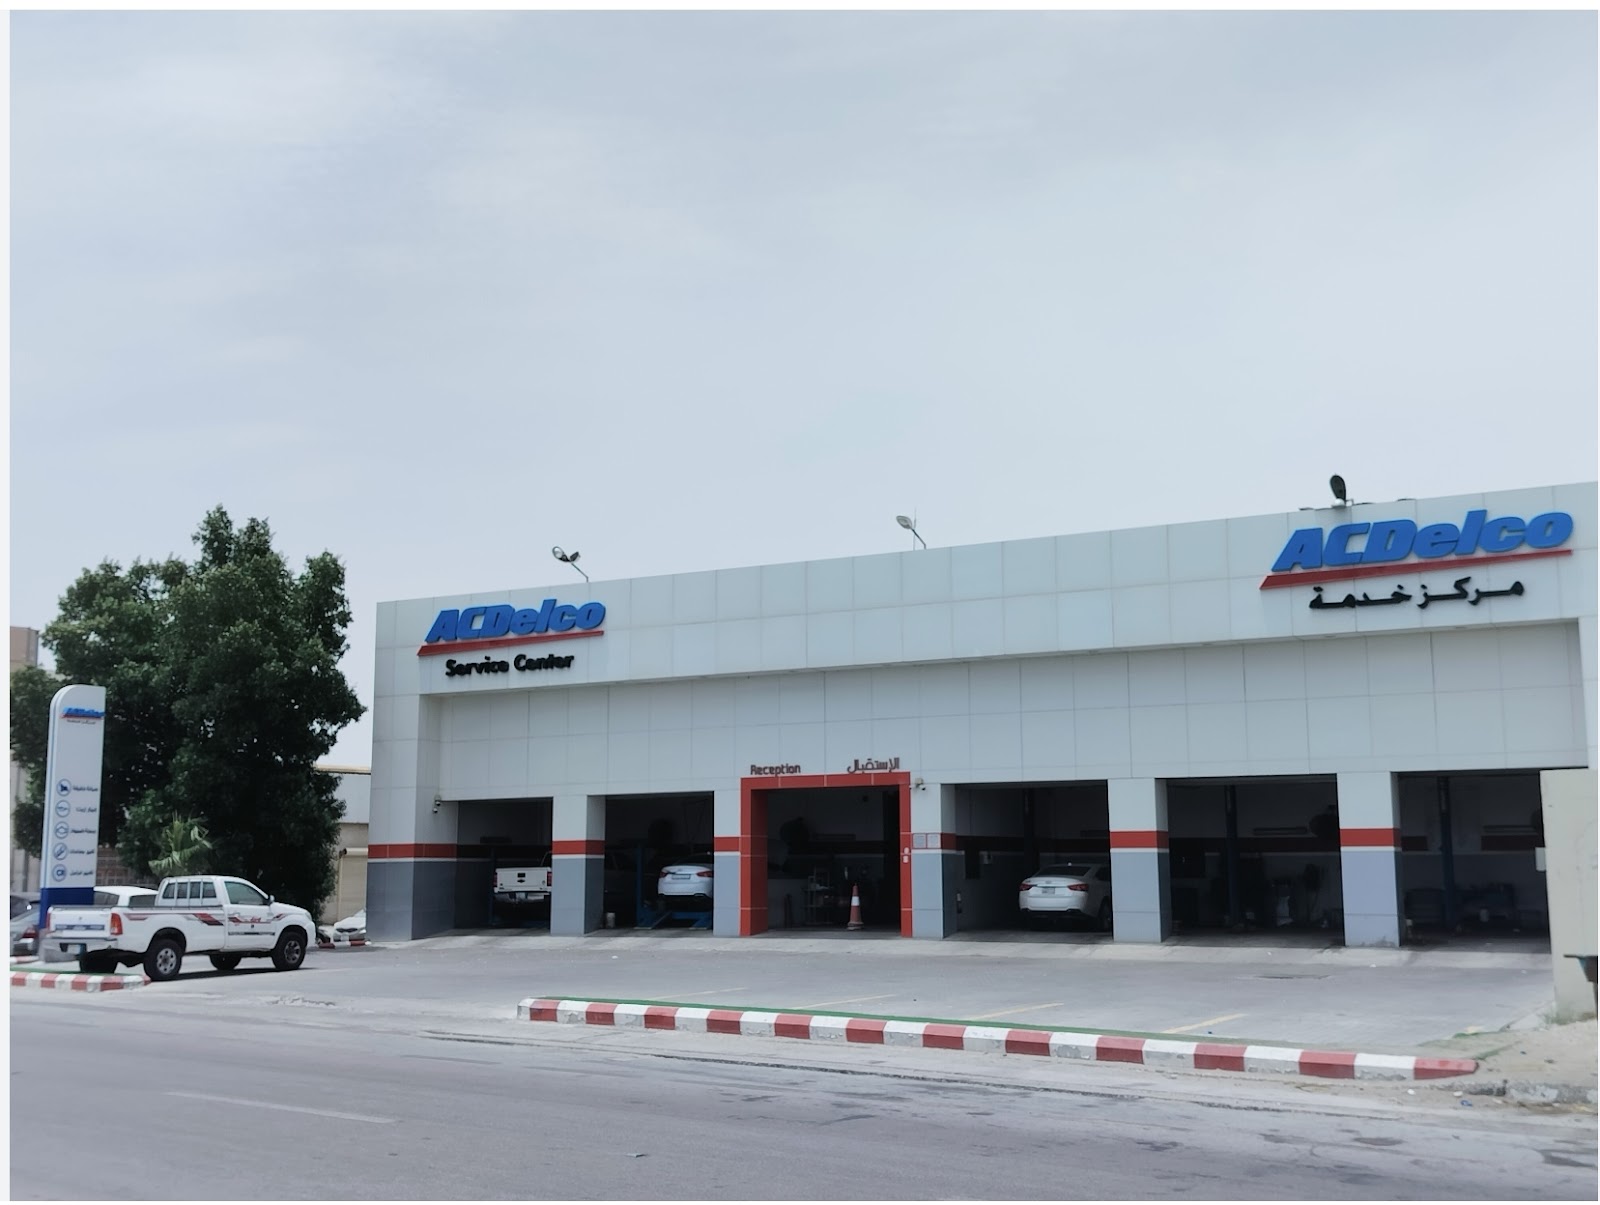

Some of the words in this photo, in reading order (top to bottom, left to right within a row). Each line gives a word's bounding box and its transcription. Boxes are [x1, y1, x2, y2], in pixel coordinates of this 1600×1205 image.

[1271, 509, 1574, 572] ACDelco
[1308, 584, 1413, 609] خدمة
[1416, 576, 1525, 609] مركز
[424, 598, 607, 643] ACDelco
[445, 656, 509, 677] Service
[513, 654, 575, 672] Center
[750, 763, 801, 777] Reception
